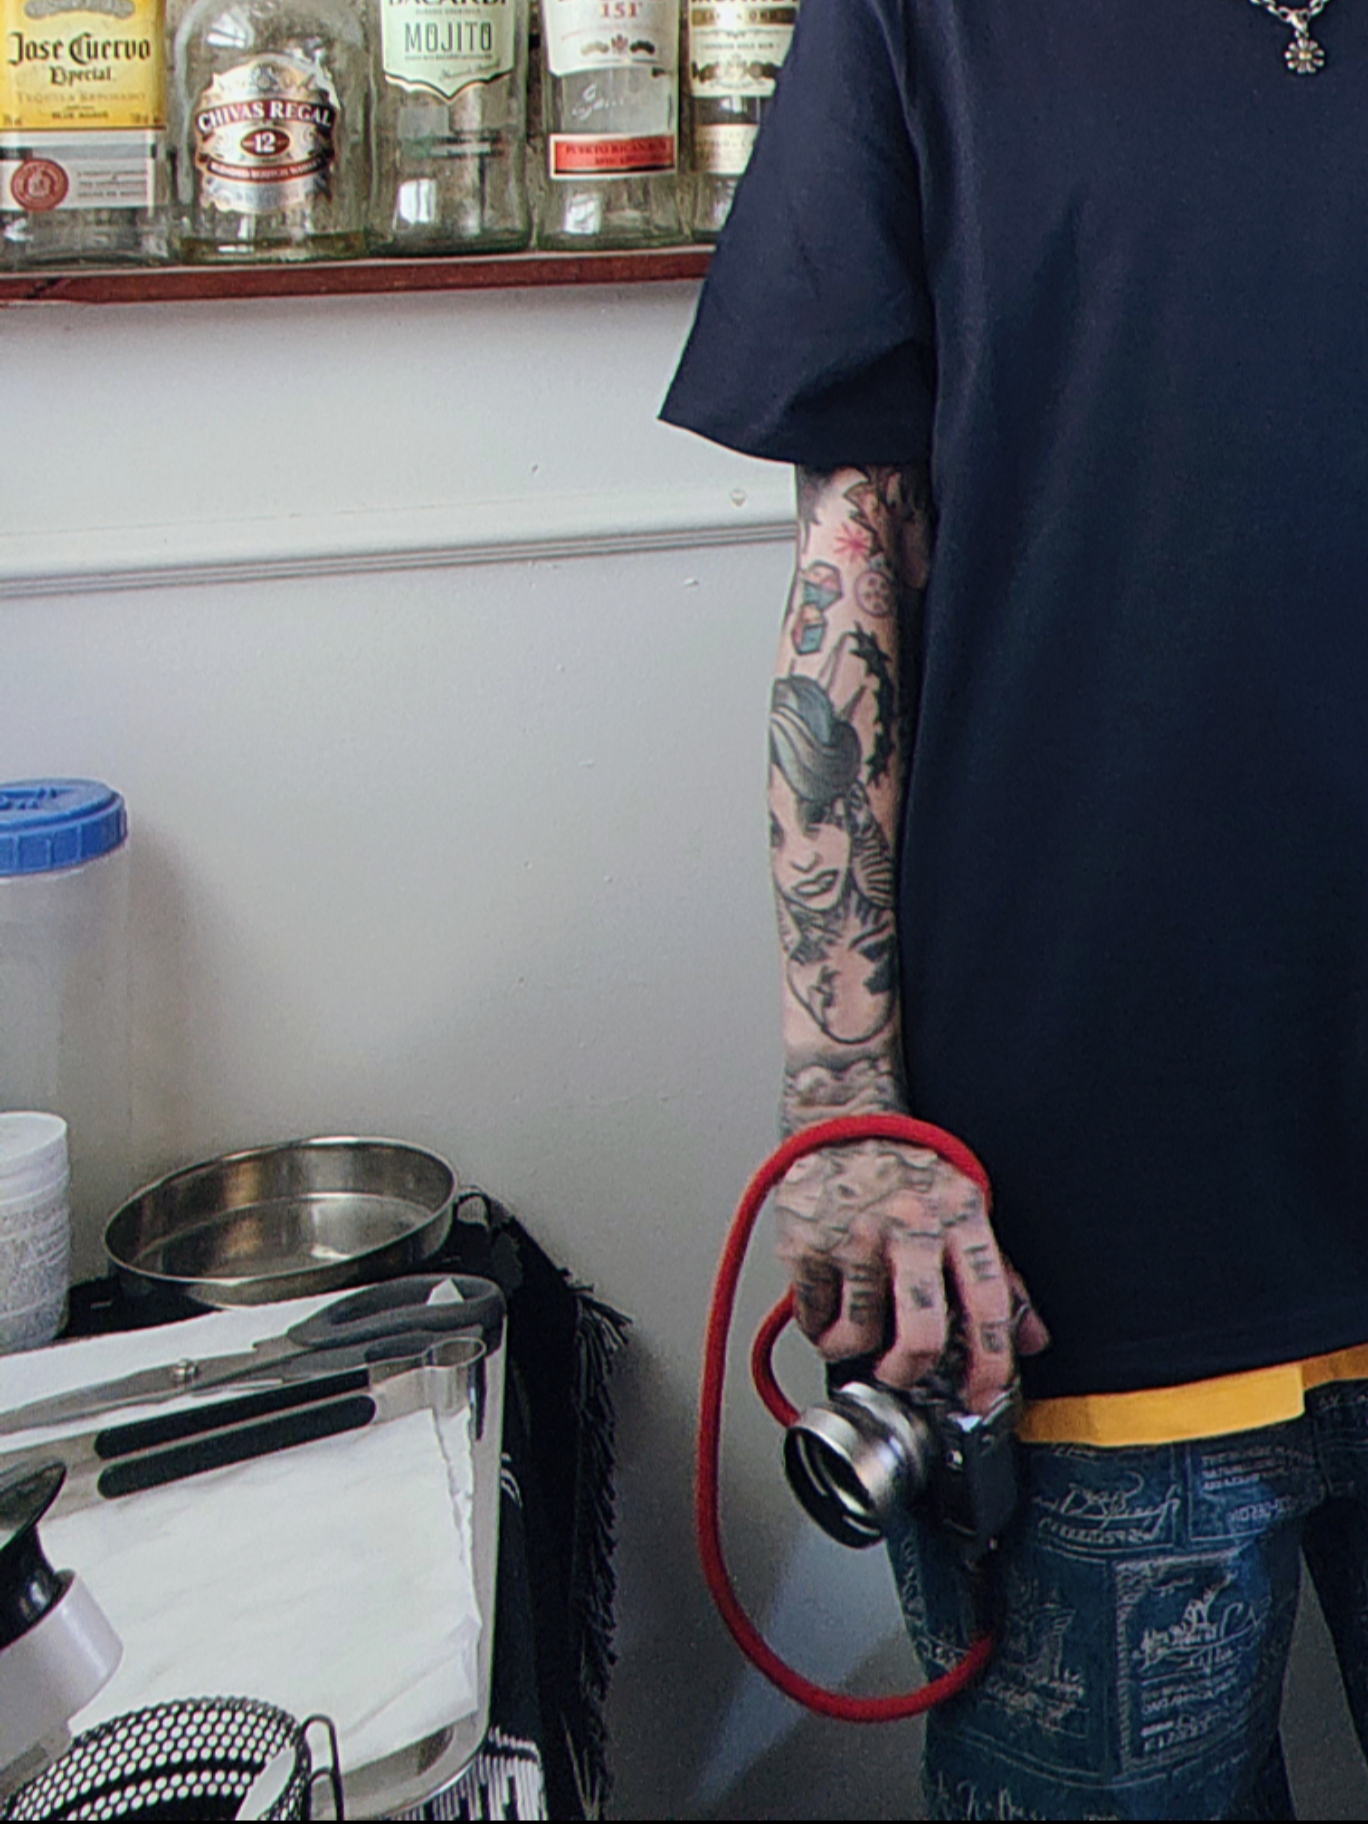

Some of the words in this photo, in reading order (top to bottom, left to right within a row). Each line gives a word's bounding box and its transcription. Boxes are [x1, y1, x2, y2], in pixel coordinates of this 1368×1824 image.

[8, 30, 64, 66] Jose
[68, 30, 151, 66] Cuervo
[404, 21, 492, 53] MOJITO
[198, 101, 265, 133] CHIVAS
[269, 100, 333, 128] REGAL
[253, 131, 277, 154] 12
